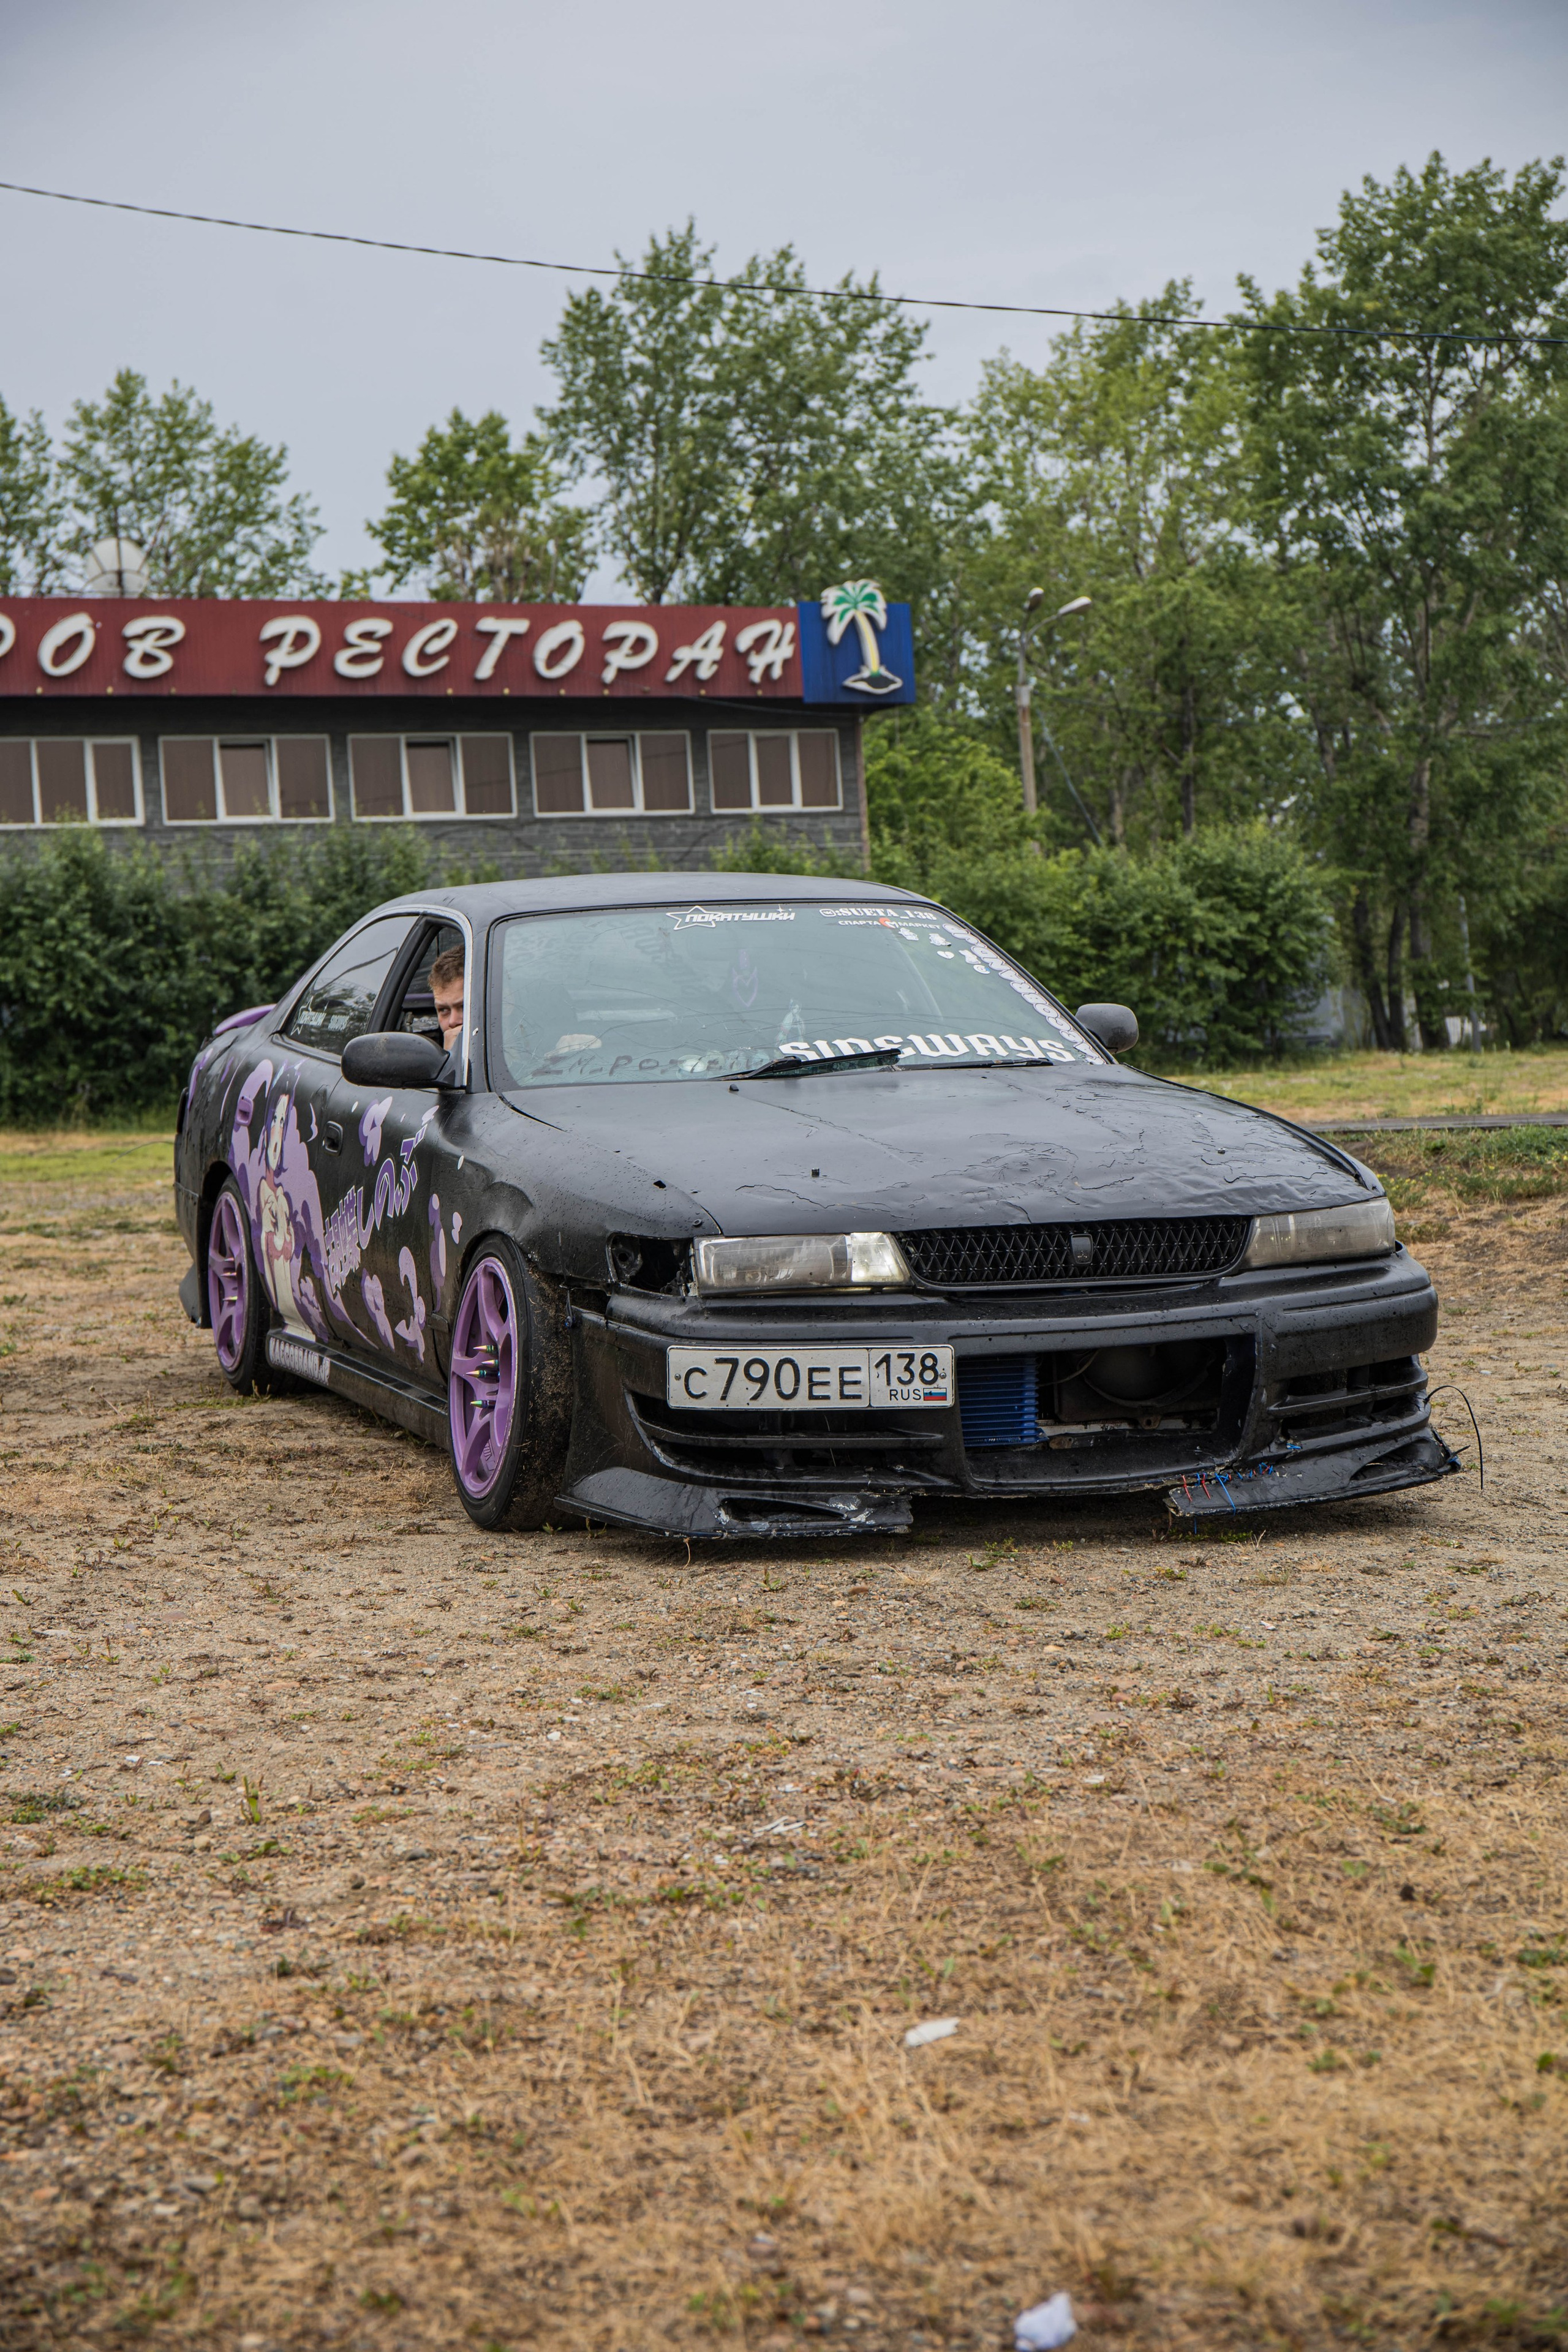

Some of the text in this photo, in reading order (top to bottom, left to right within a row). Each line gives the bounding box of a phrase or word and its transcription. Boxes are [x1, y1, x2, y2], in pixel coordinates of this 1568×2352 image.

[259, 614, 796, 687] РЕСТОРАН
[684, 911, 796, 923] ПОКАТУШКИ
[778, 1033, 1076, 1062] SIDEWAYS
[873, 1352, 939, 1385] 138
[889, 1389, 921, 1401] RUS
